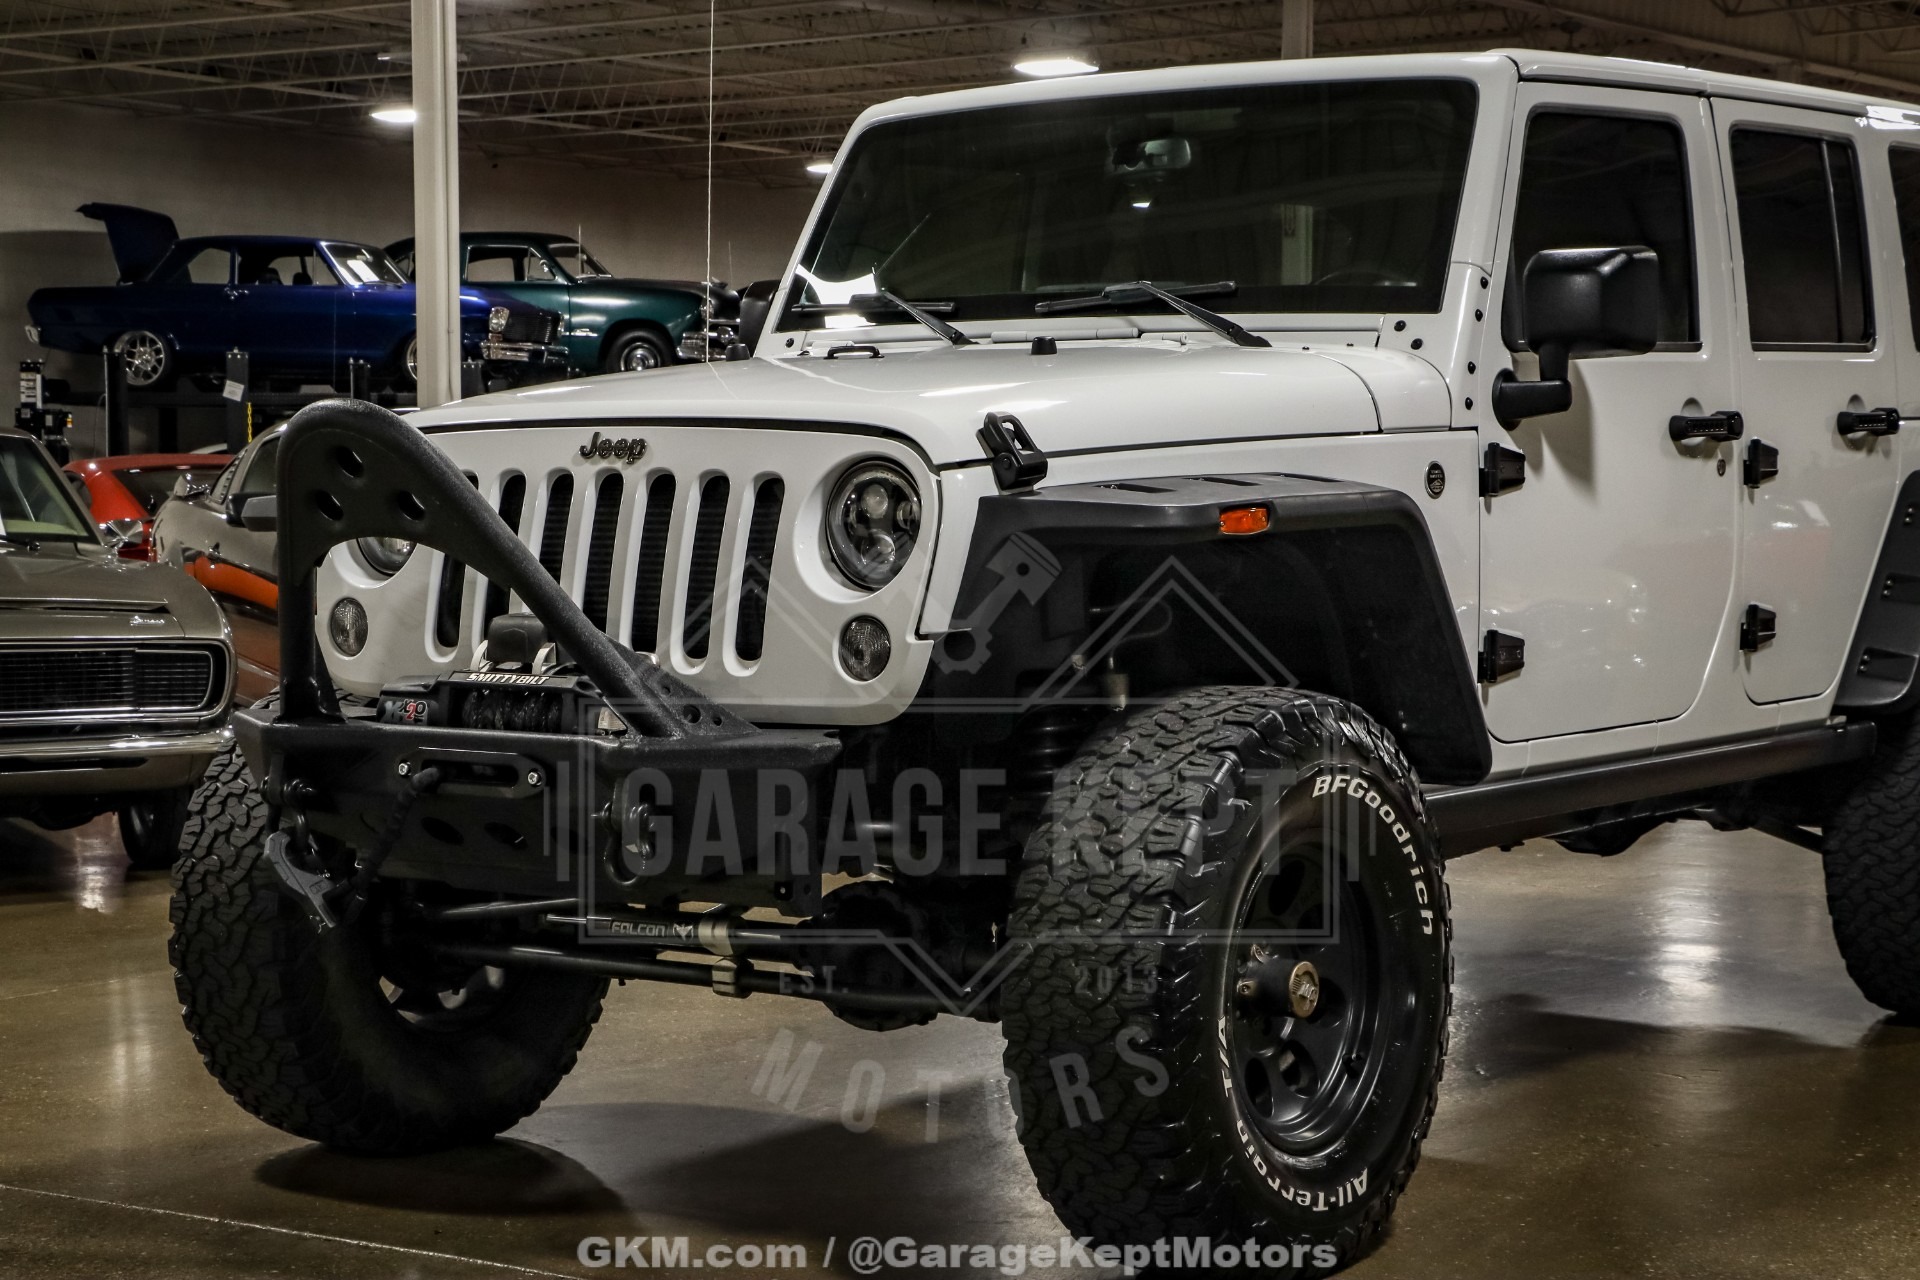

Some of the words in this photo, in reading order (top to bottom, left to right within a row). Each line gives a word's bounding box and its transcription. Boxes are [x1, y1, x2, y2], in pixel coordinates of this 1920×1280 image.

[579, 431, 647, 465] Jeep
[466, 672, 549, 685] SMITTYBILT
[1312, 775, 1433, 935] BFGoodrich
[611, 921, 666, 937] FALCON
[1218, 1015, 1233, 1097] T/A
[1236, 1119, 1368, 1211] All-Terrain
